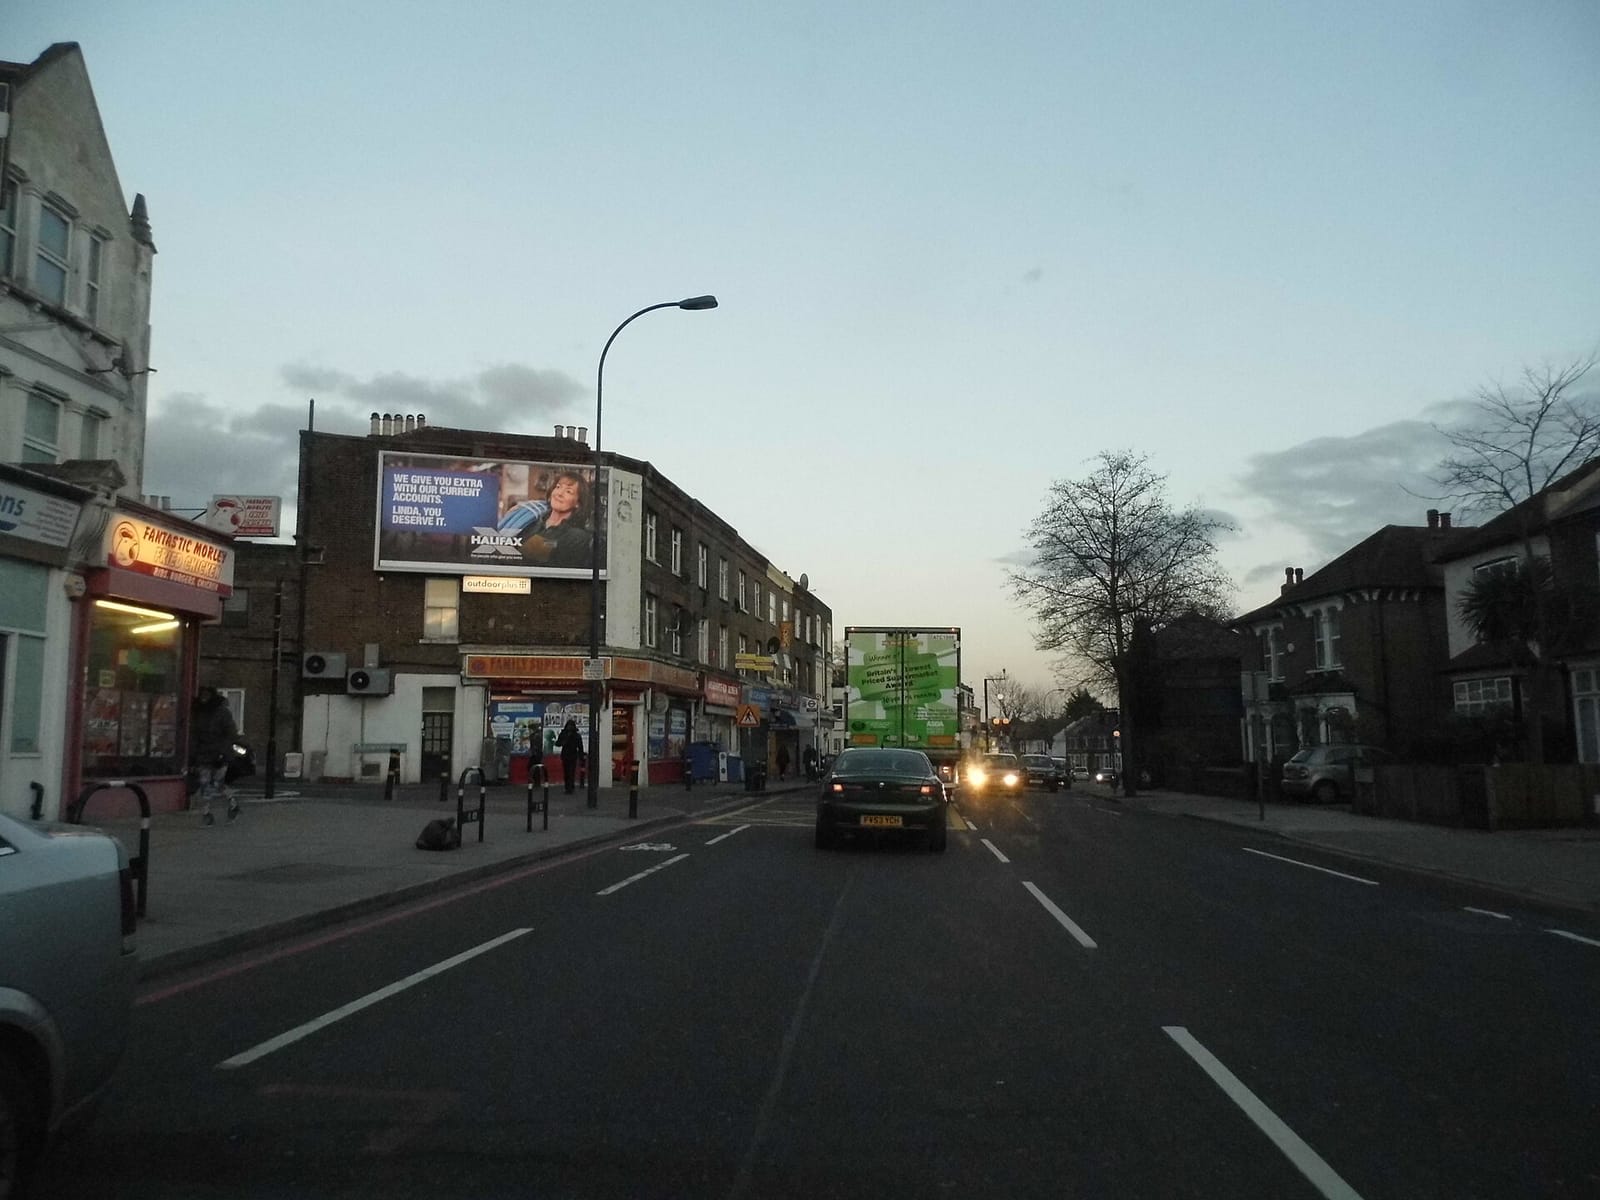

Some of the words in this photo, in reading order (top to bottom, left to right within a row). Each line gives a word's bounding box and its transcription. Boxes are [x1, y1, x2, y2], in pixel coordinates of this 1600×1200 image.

[393, 473, 409, 484] WE
[411, 474, 432, 485] GIVE
[434, 476, 452, 487] YOU
[453, 477, 484, 489] EXTRA
[393, 482, 417, 493] WITH
[419, 484, 438, 495] OUR
[439, 486, 481, 497] CURRENT
[392, 492, 443, 504] ACCOUNTS.
[0, 493, 27, 517] ns
[392, 505, 422, 516] LINDA,
[423, 507, 442, 517] YOU
[392, 515, 435, 526] DESERVE
[436, 517, 447, 528] IT.
[143, 526, 192, 553] FANTASTIC
[193, 541, 228, 564] MORLEY
[471, 535, 523, 547] HALIFAX
[866, 667, 897, 677] Britain's
[862, 677, 885, 686] Priced
